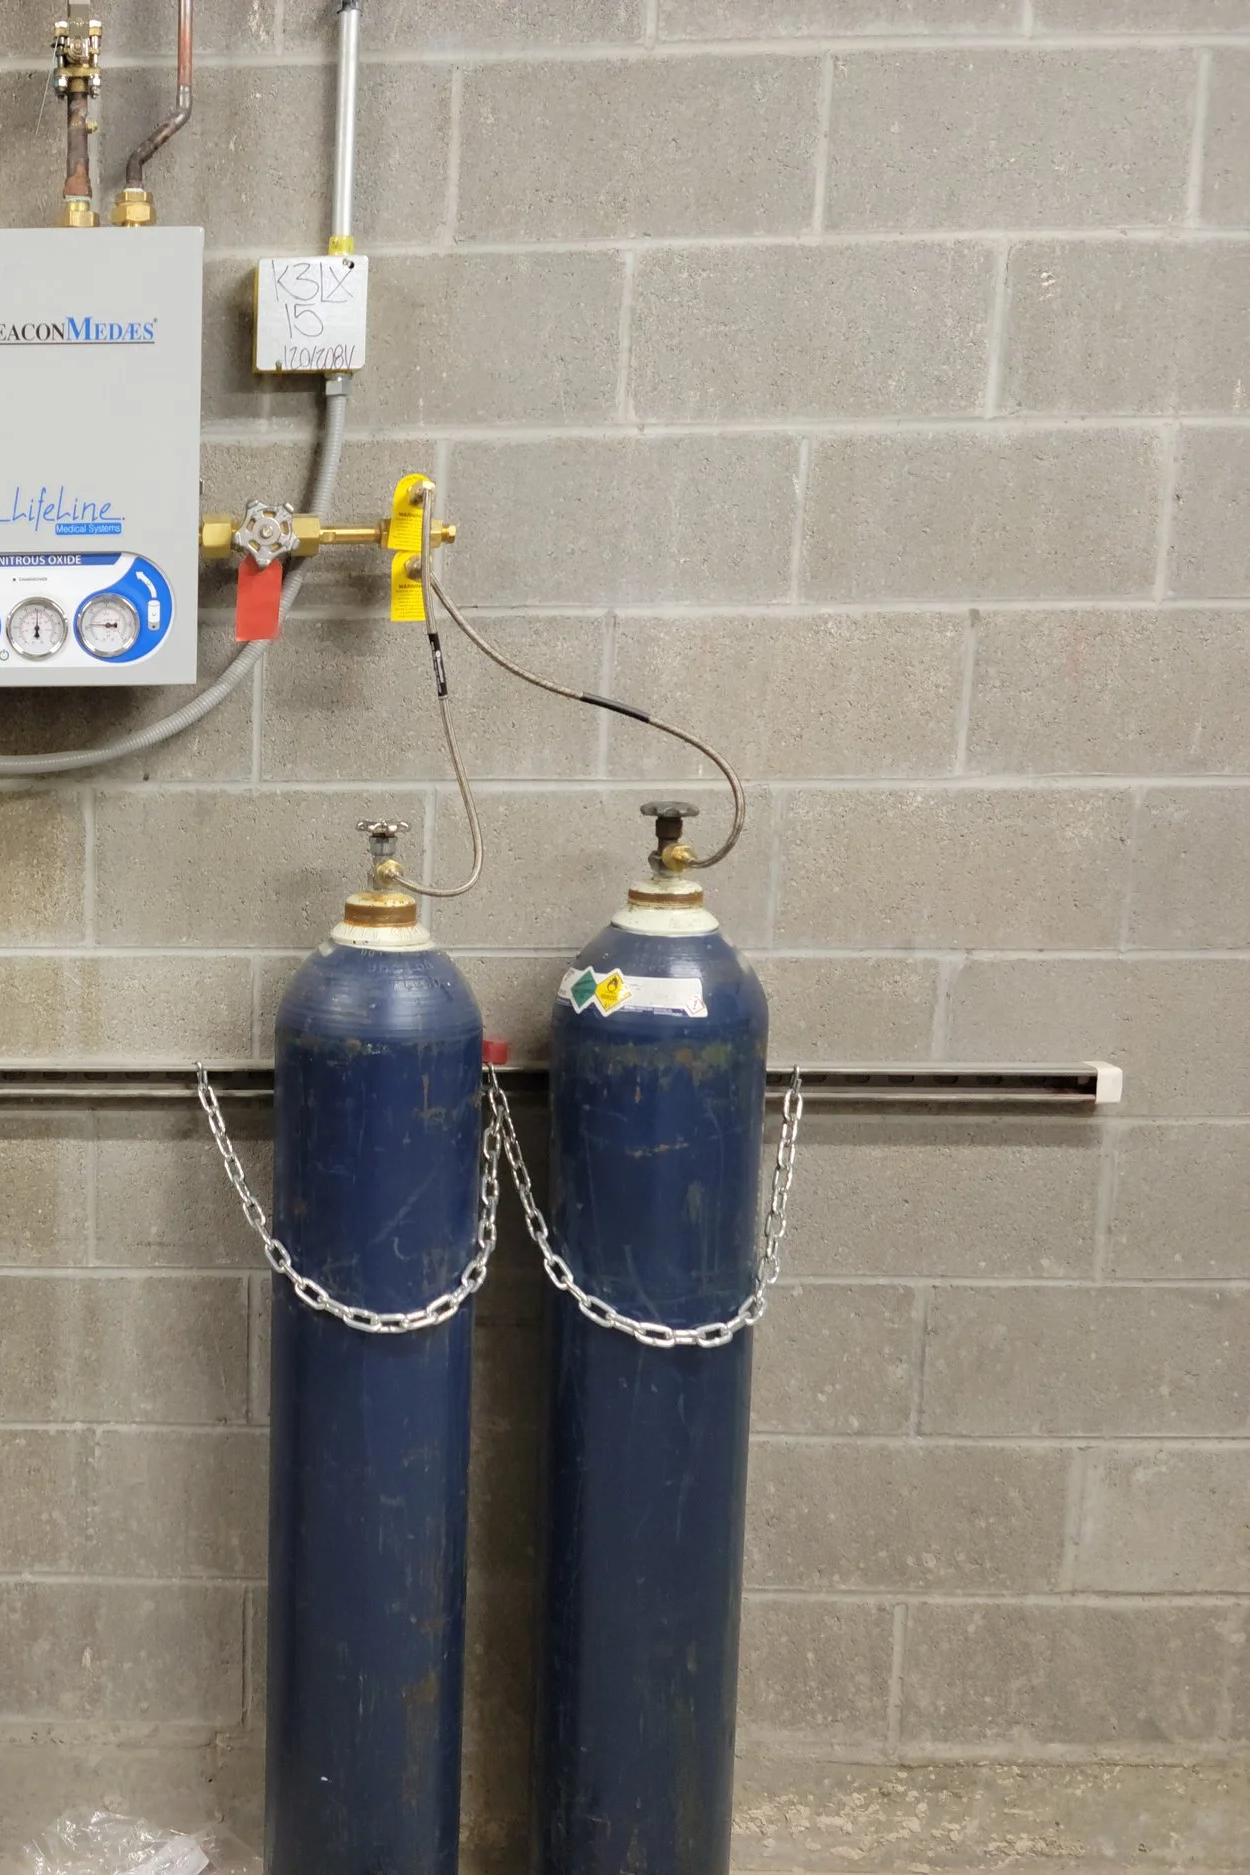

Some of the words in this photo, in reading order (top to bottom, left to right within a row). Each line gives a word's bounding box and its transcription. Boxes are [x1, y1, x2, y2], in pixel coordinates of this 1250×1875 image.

[285, 303, 324, 339] 15
[12, 485, 121, 532] LifeLine
[56, 523, 87, 534] Medical
[89, 523, 121, 535] Systems
[48, 555, 82, 565] OXIDE
